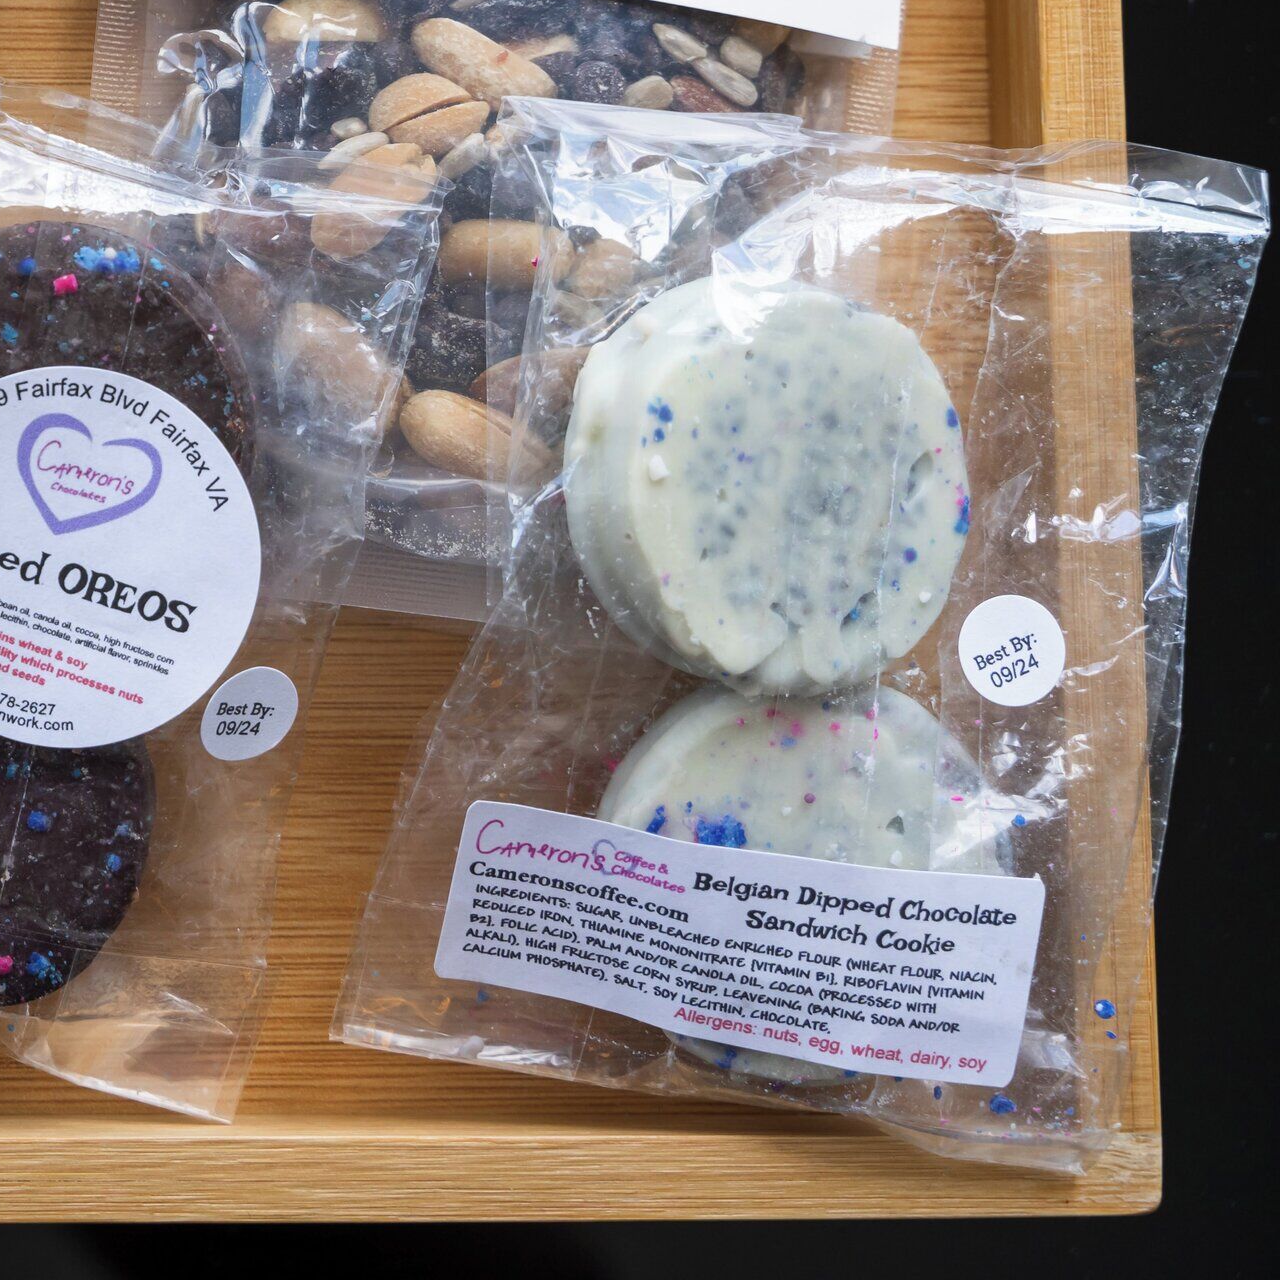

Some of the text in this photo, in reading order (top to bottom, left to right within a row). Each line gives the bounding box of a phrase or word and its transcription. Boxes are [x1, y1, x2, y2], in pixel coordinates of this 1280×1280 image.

[15, 377, 94, 400] Fairfax
[99, 384, 149, 416] Blvd
[149, 409, 211, 477] Fairfax
[205, 476, 229, 512] VA
[50, 482, 107, 504] Chocolates
[58, 563, 198, 633] OREOS
[18, 640, 52, 657] wheat
[54, 650, 63, 661] &
[66, 656, 88, 670] soy
[973, 633, 1037, 671] Best By:
[990, 653, 1039, 688] 09/24
[12, 668, 45, 686] seeds
[21, 655, 54, 673] which
[56, 668, 115, 695] processes
[118, 690, 143, 704] nuts
[216, 702, 275, 719] Best By:
[216, 720, 261, 736] 09/24
[611, 865, 686, 893] Chocolates
[614, 850, 669, 874] Coffee &
[469, 861, 689, 923] Cameronscoffee.com
[693, 872, 1017, 927] Belgian Dipped Chocolate
[476, 884, 571, 909] INGREDIENTS:
[629, 915, 720, 947] UNBLEACHED
[724, 939, 793, 958] ENRICHED
[798, 951, 842, 967] FLOUR
[846, 958, 896, 974] (WHEAT
[745, 909, 955, 955] Sandwich Cookie
[673, 1007, 987, 1073] Allergens: nuts, egg, wheat, dairy, soy
